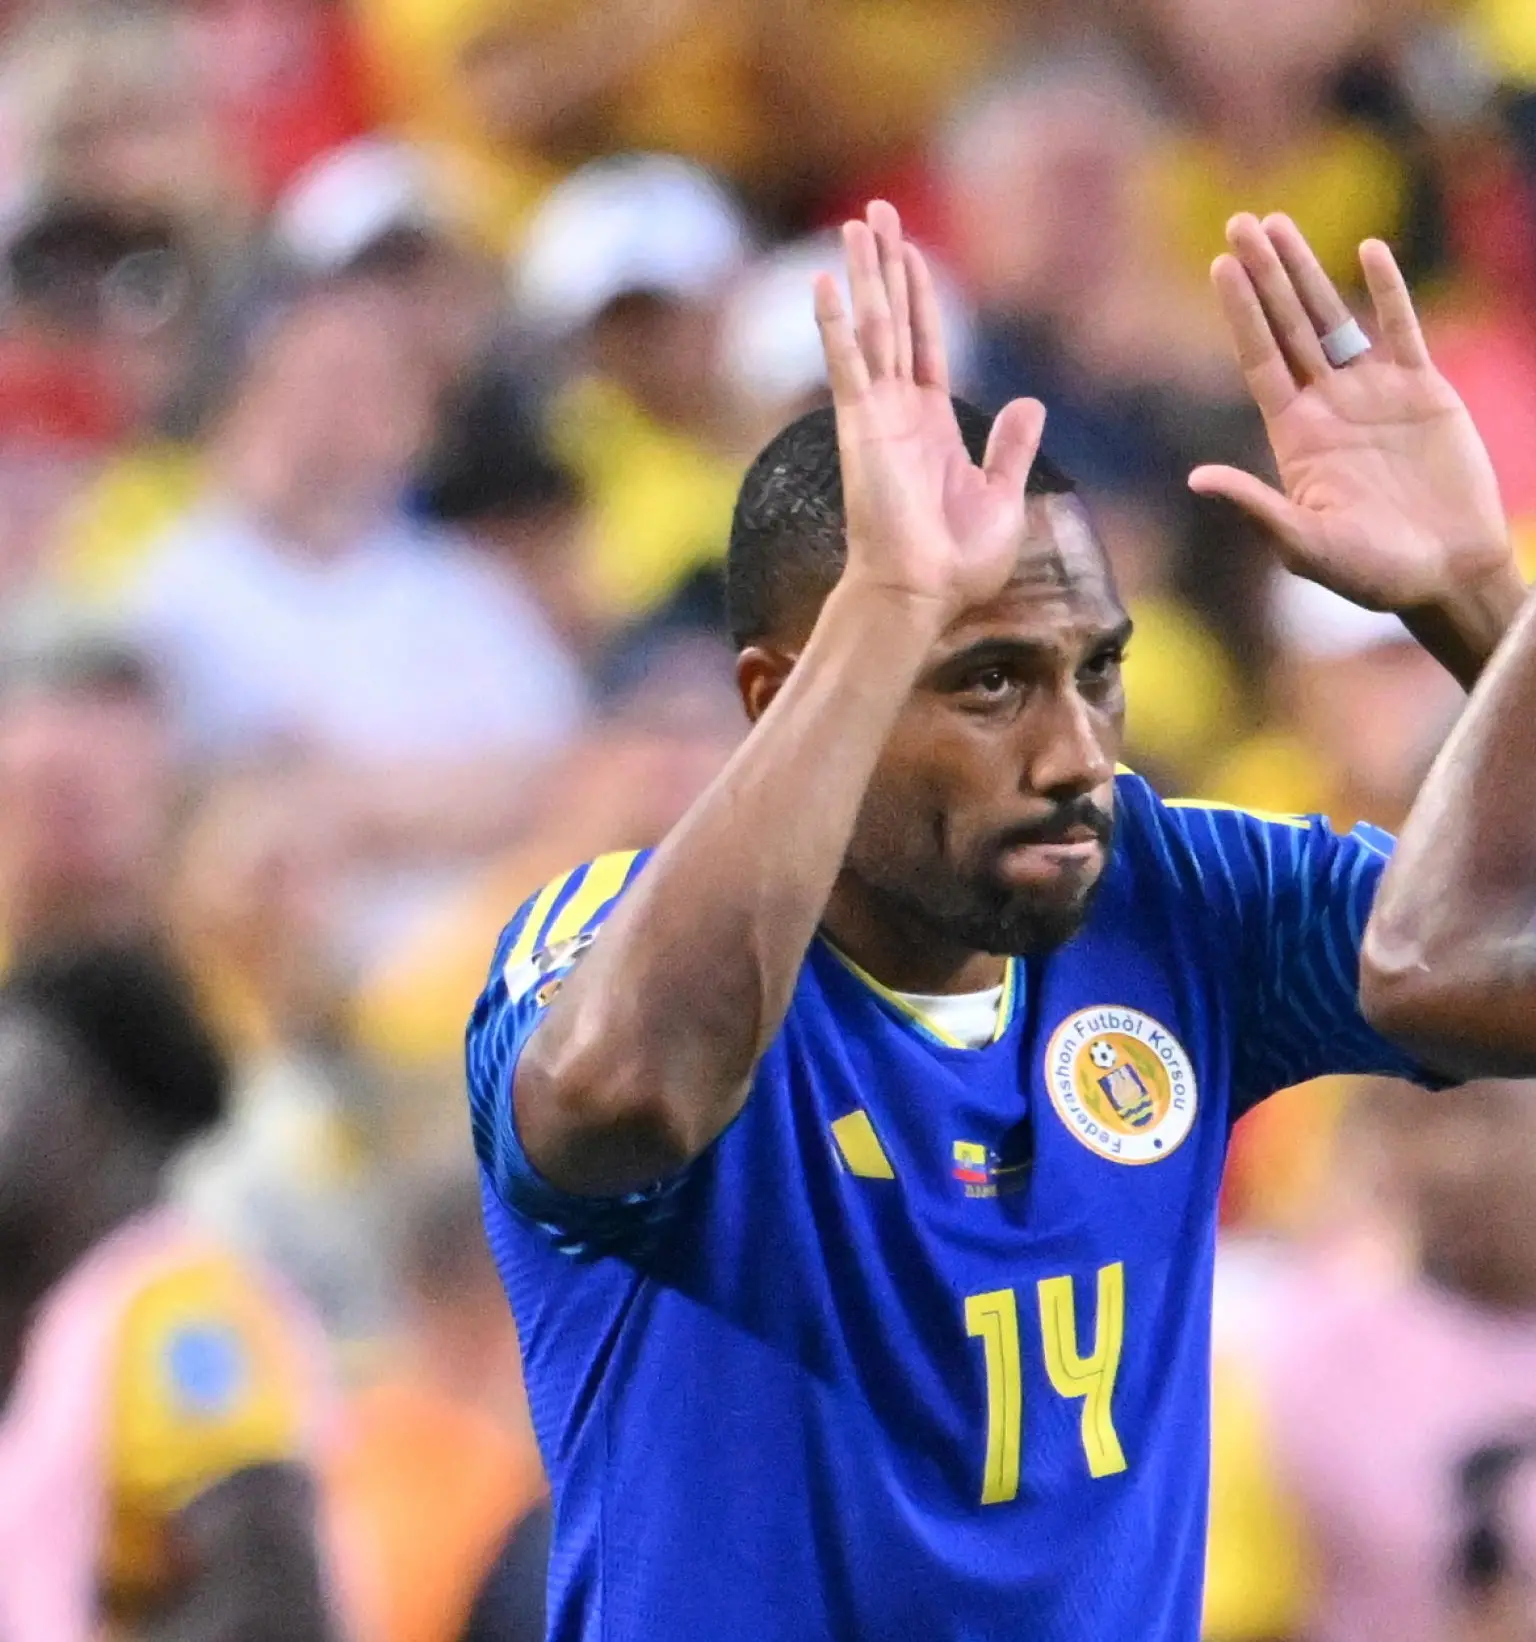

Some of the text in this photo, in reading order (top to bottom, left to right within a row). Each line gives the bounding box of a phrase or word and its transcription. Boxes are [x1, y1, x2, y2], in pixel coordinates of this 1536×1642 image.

[1073, 1011, 1143, 1040] Futbòl
[1055, 1039, 1122, 1154] Federashon
[964, 1260, 1128, 1505] 14
